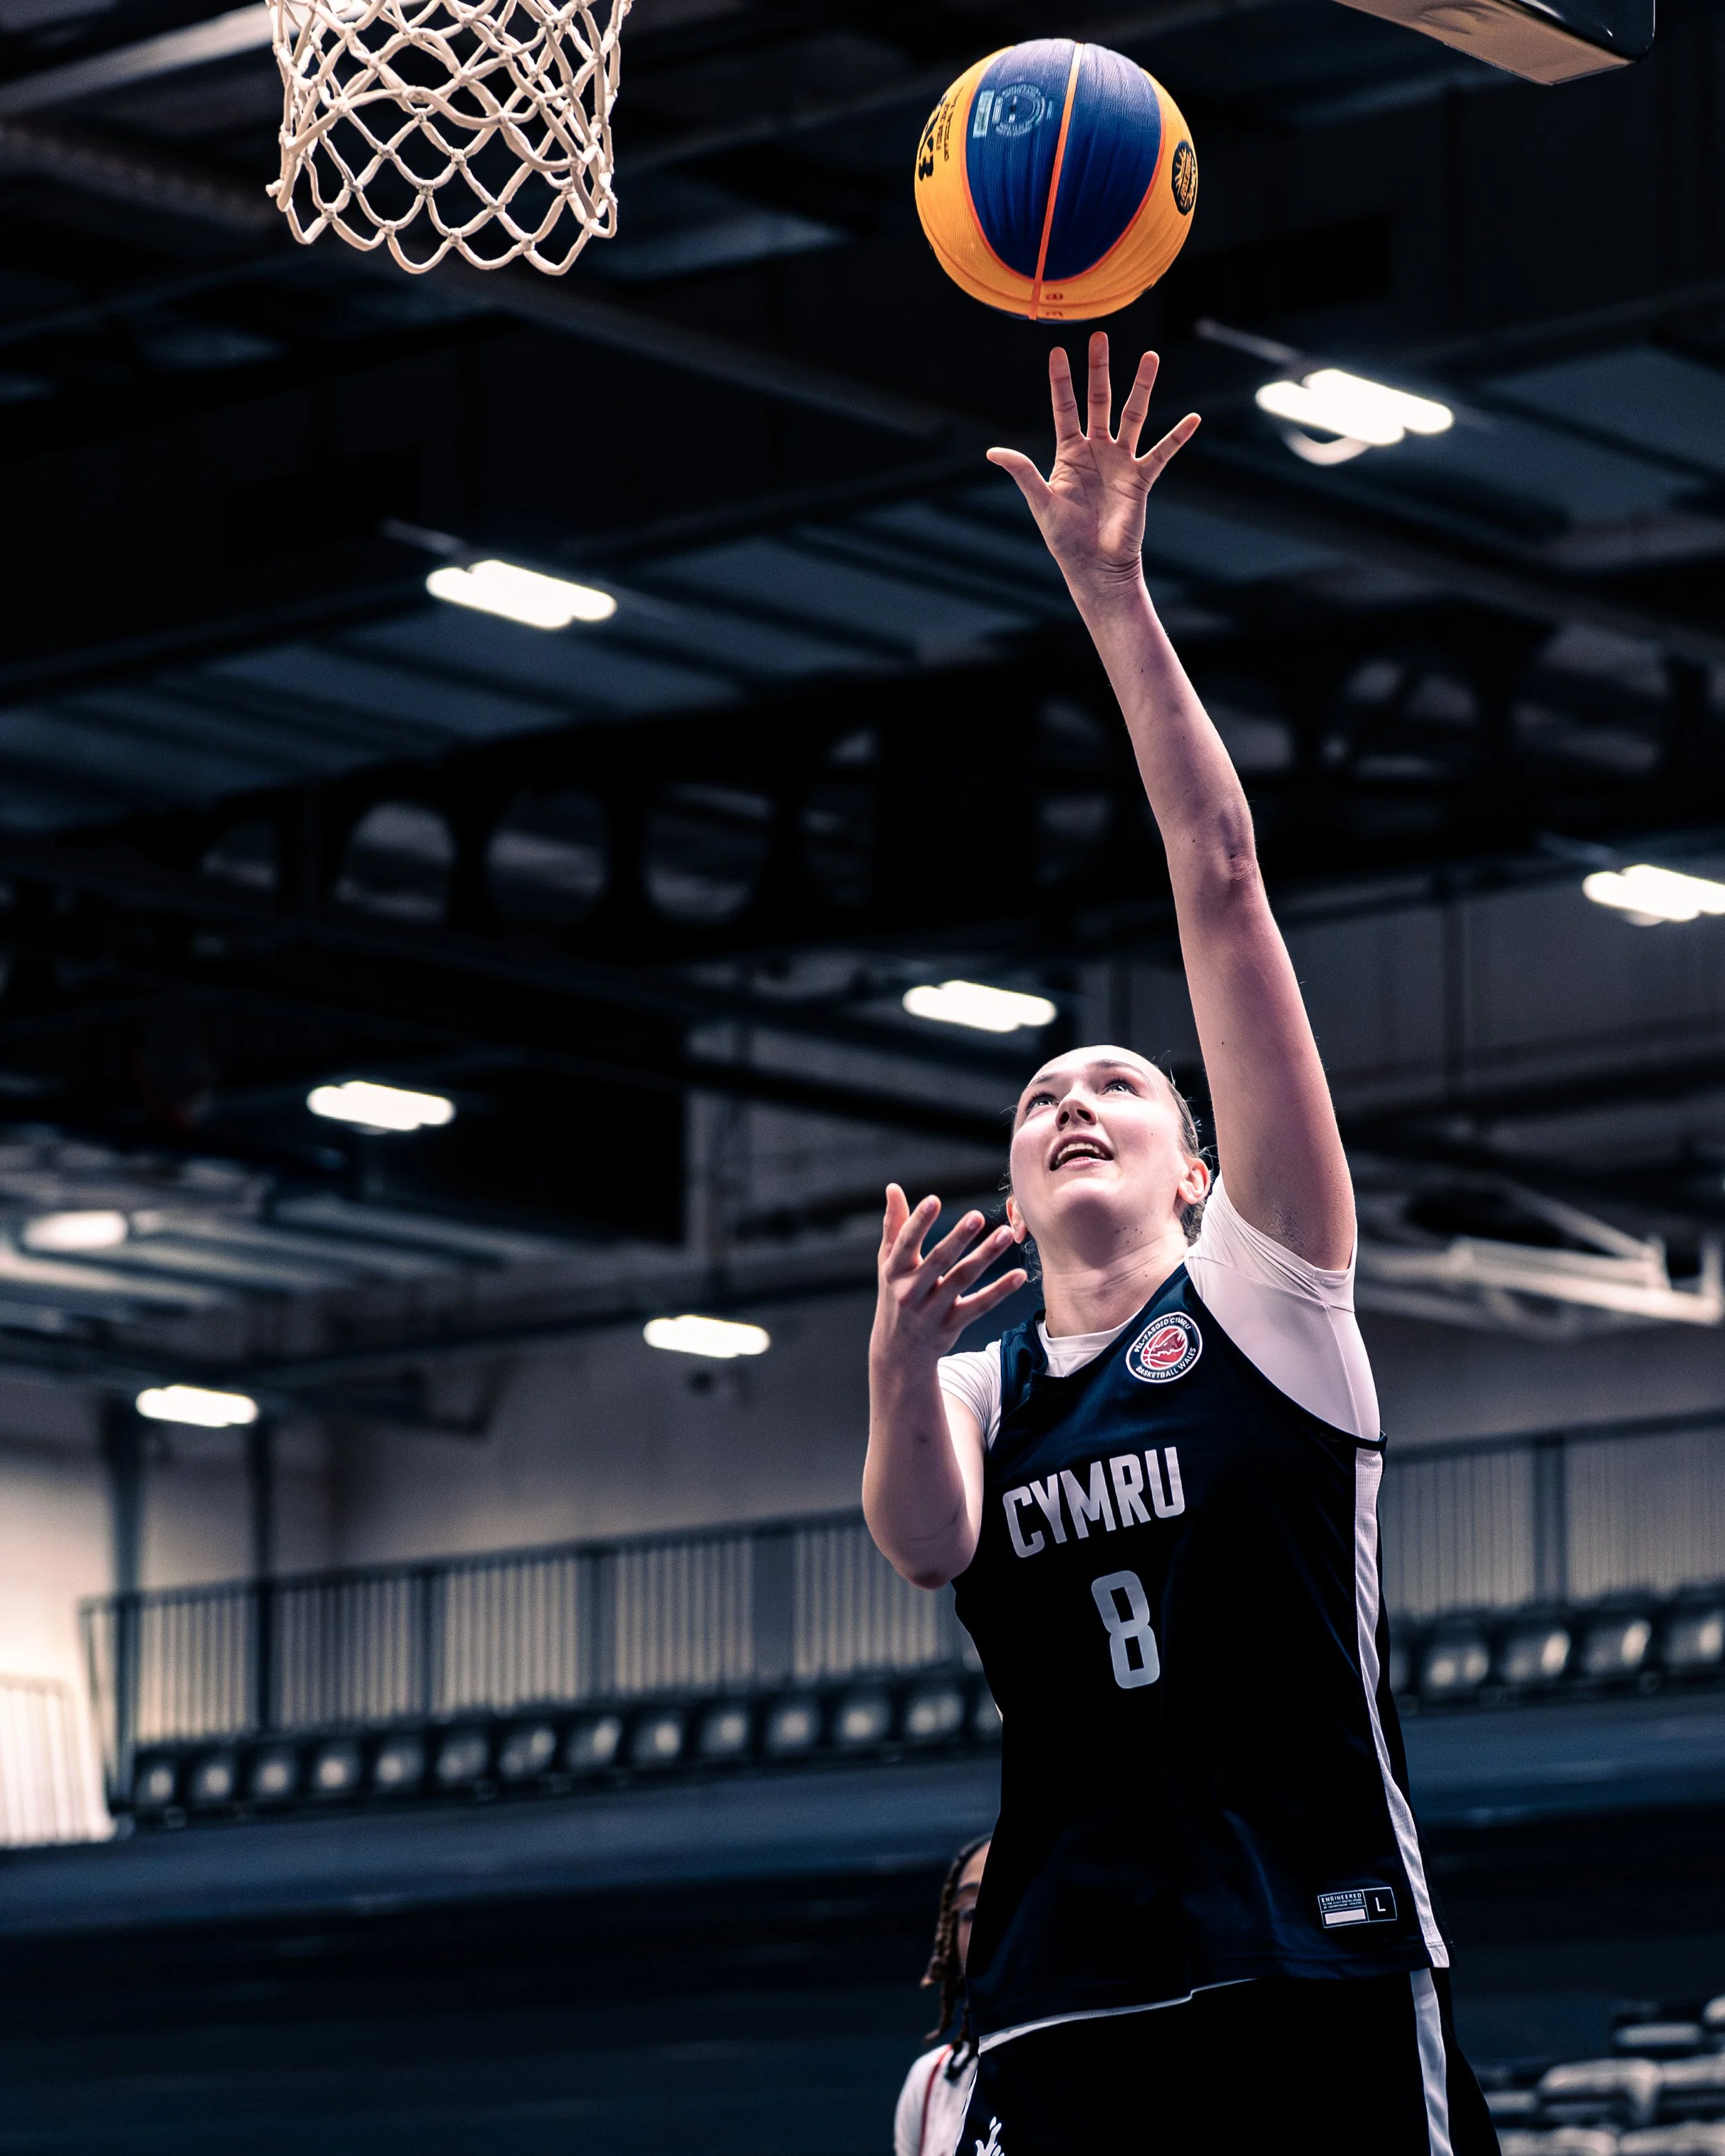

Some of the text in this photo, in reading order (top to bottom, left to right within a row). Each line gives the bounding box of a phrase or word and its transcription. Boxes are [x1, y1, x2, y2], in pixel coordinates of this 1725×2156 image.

[1170, 1316, 1191, 1329] CYMRU
[1135, 1347, 1196, 1378] BASKETBALL WALES
[1003, 1446, 1185, 1558] CYMRU
[1091, 1570, 1161, 1689] 8
[1321, 1892, 1362, 1903] ENGINEERED
[1375, 1897, 1386, 1912] L
